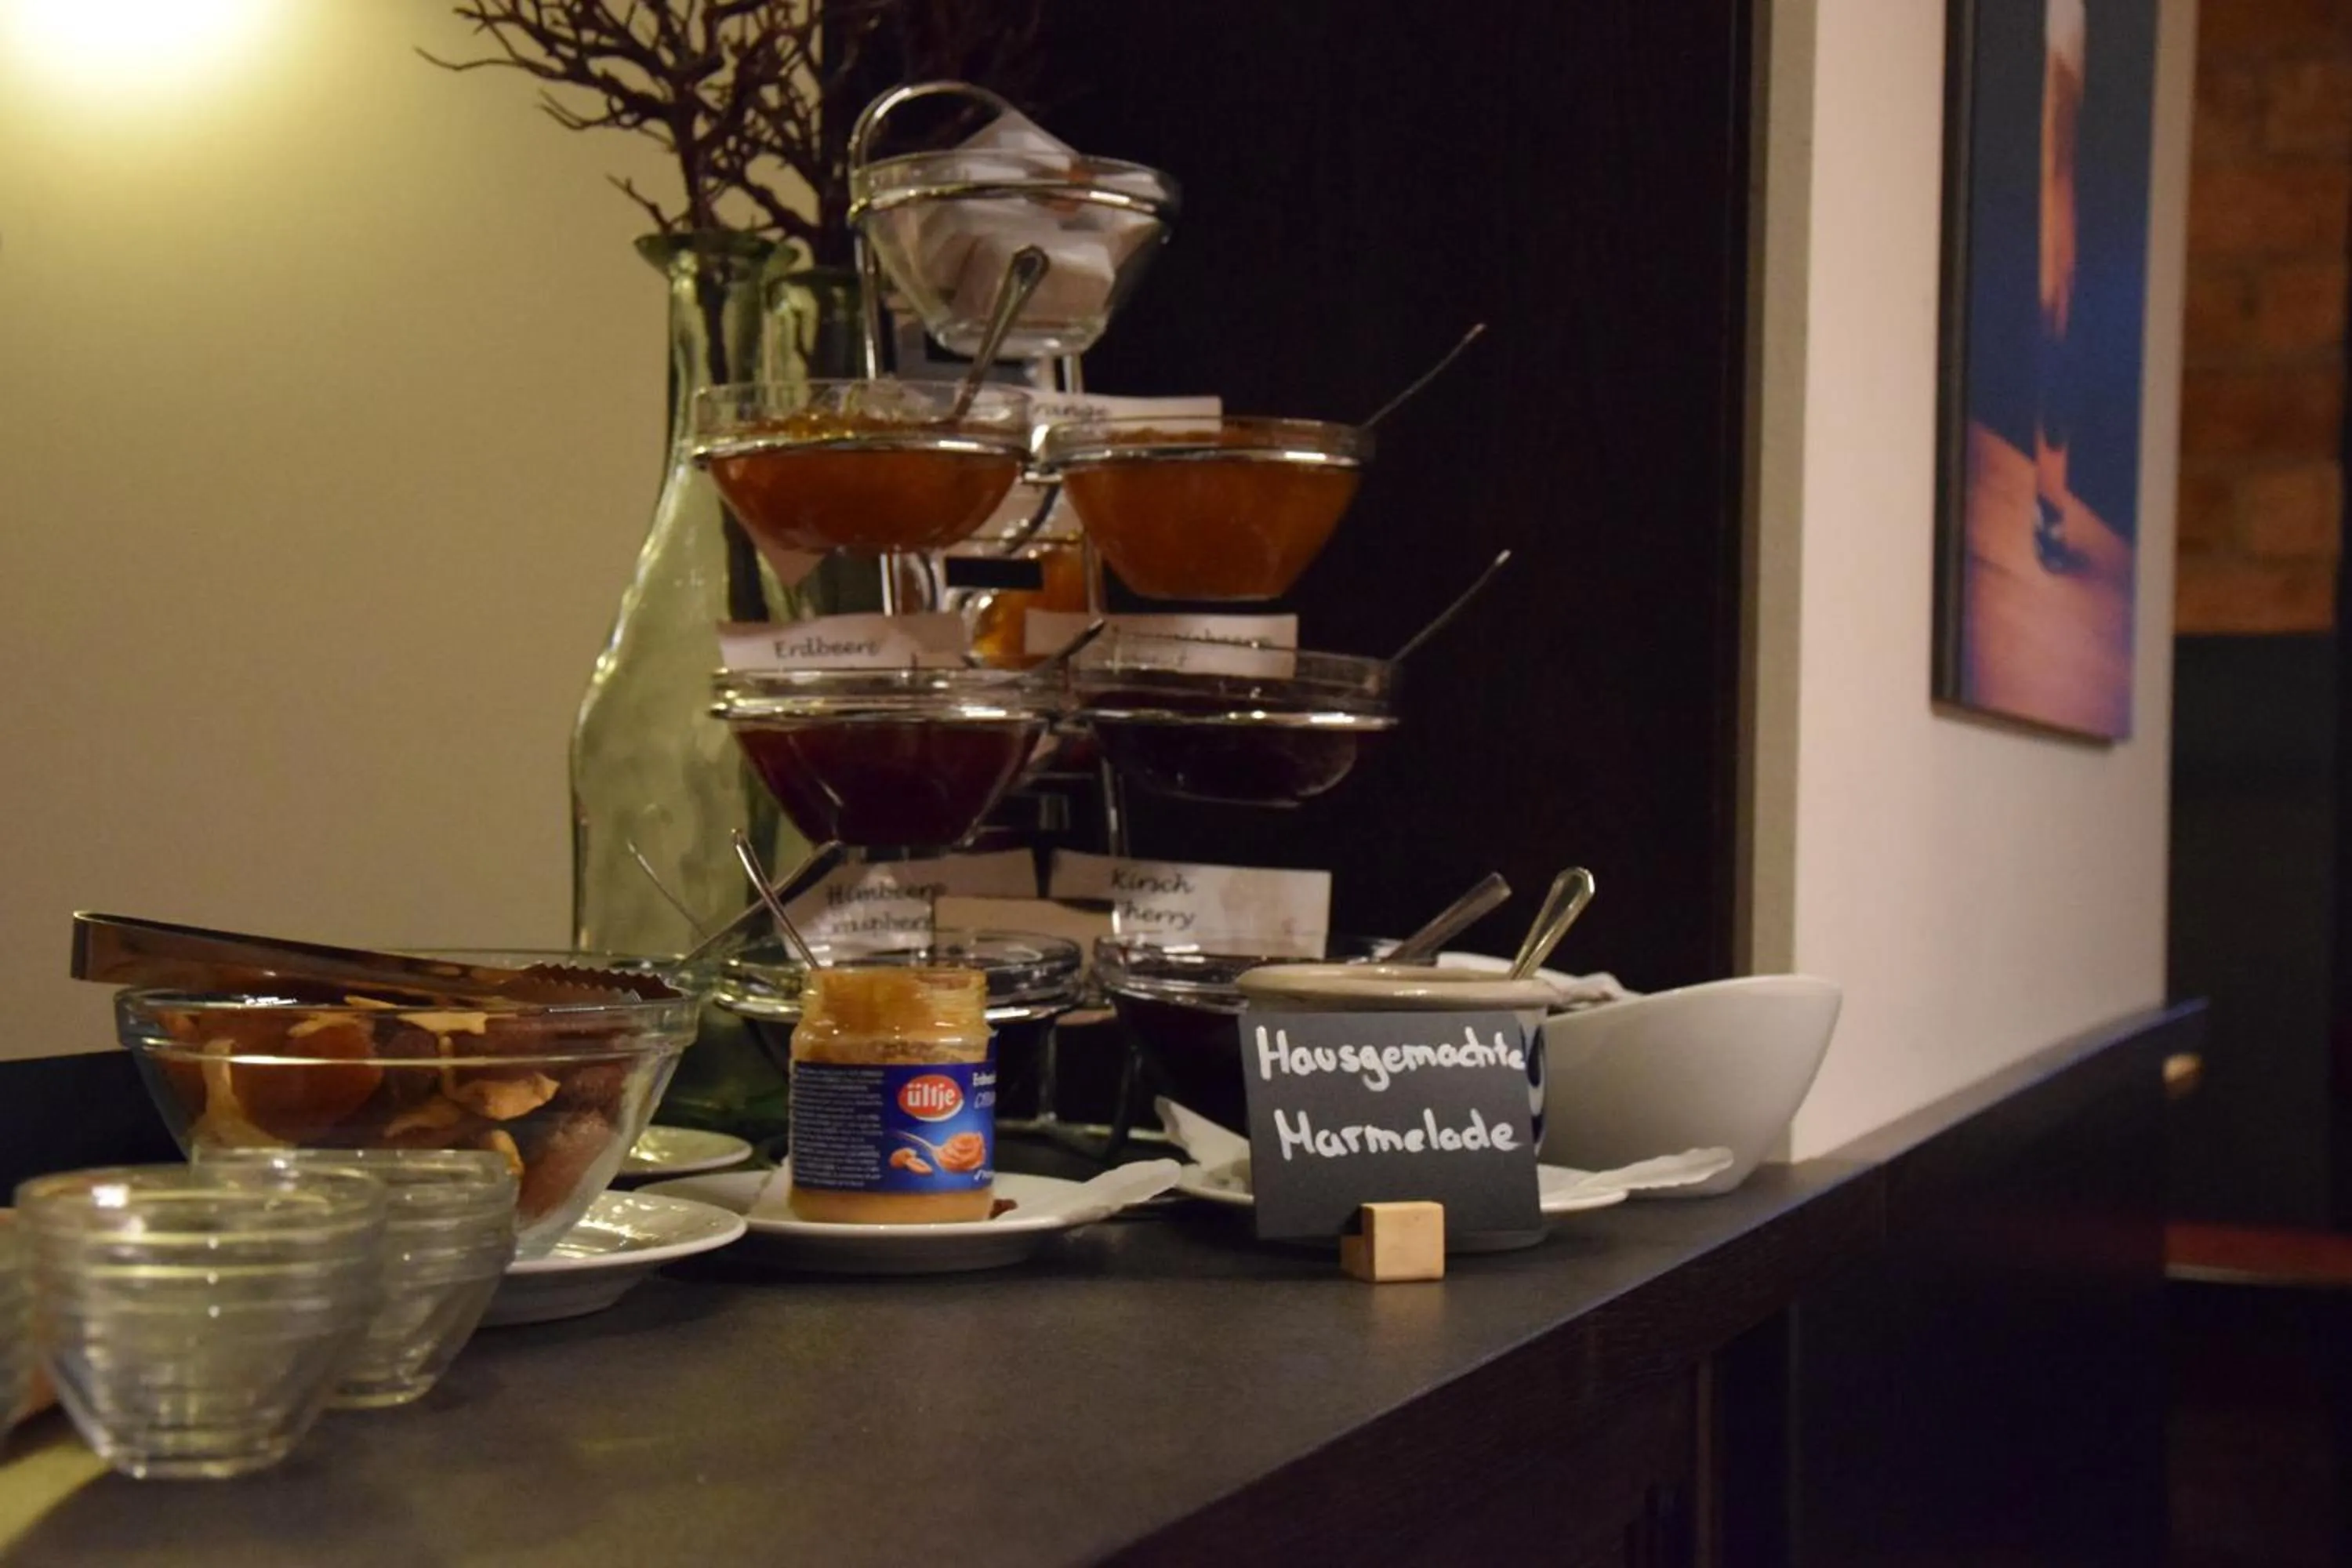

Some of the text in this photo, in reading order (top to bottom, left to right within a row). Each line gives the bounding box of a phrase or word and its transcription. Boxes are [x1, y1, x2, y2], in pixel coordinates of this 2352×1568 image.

[773, 636, 880, 659] Erdbeere
[1112, 868, 1195, 895] Kirsch
[1123, 901, 1196, 931] herry
[1256, 1025, 1525, 1091] Hausgemachte
[907, 1083, 956, 1110] ültje
[1273, 1108, 1523, 1160] Marmelade
